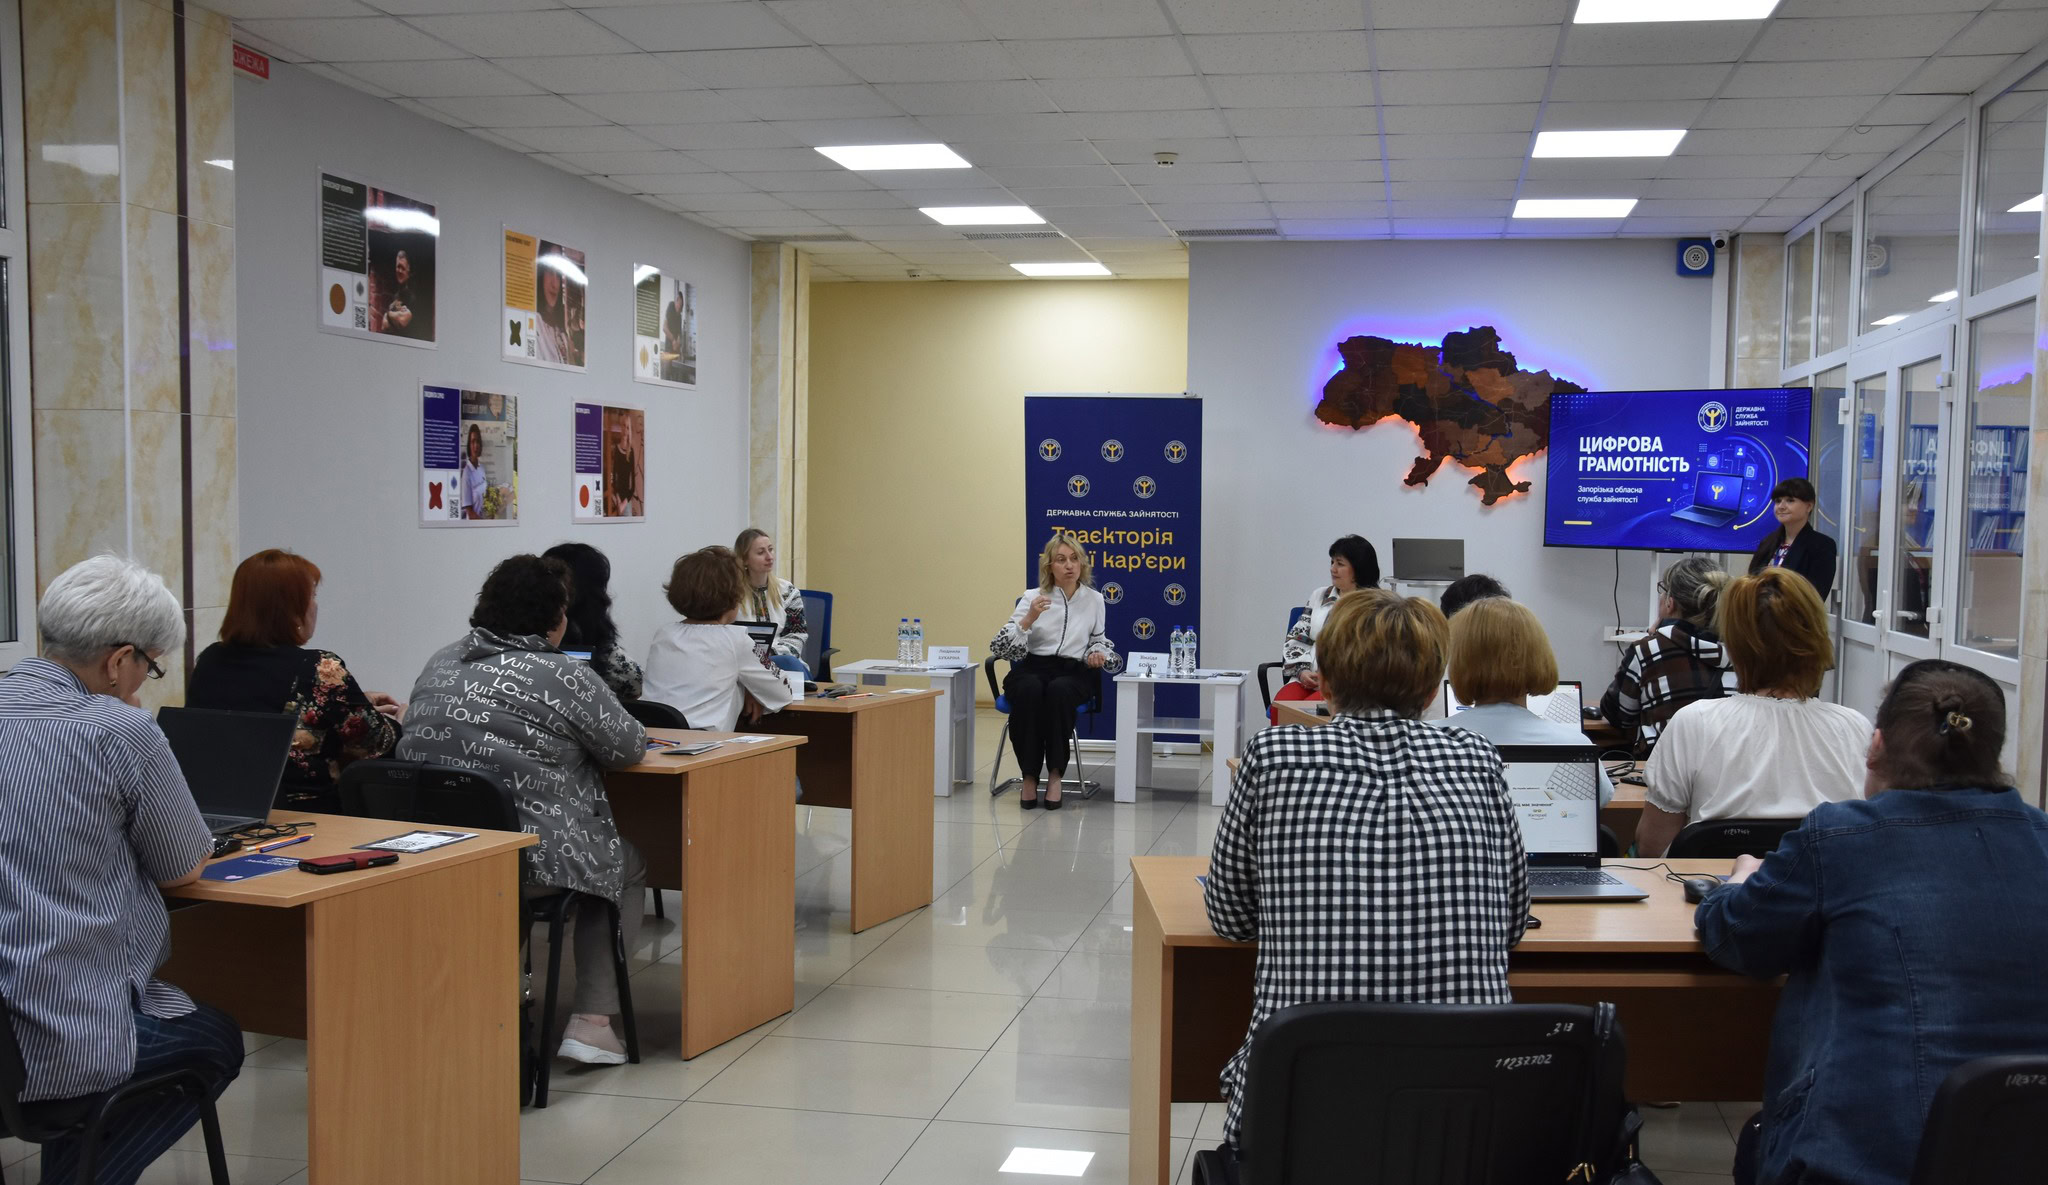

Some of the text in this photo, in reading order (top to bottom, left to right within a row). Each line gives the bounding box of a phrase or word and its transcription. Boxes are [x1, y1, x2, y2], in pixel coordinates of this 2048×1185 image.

[233, 49, 265, 74] ОЖЕЖА
[1579, 436, 1663, 454] ЦИФРОВА
[1578, 456, 1690, 472] ГРАМОТНІСТЬ
[1577, 485, 1643, 498] Запорізька обласна
[1577, 495, 1638, 504] служба зайнятості
[1046, 509, 1179, 519] ДЕРЖАВНА СЛУЖБА ЗАЙНЯТОСТІ
[501, 654, 533, 672] VUIT
[525, 652, 556, 669] PARIS
[423, 677, 457, 688] OUIS
[470, 662, 534, 686] TTON PARIS
[573, 669, 597, 694] PARIS
[464, 680, 497, 696] VUIT
[493, 676, 540, 703] LOUIS
[555, 667, 595, 703] LOUIS
[433, 693, 463, 705] TTON
[466, 692, 498, 707] PARIS
[414, 703, 440, 718] VUIT
[446, 704, 491, 724] LOUIS
[570, 699, 598, 729] TTON
[599, 704, 622, 733] VUIT
[415, 725, 452, 741] LOUIS
[484, 732, 515, 748] PARIS
[402, 748, 427, 761] VUIT
[462, 740, 495, 757] VUIT
[440, 755, 500, 773] TTON PARIS
[513, 771, 548, 792] VUIT
[539, 767, 565, 783] TTON
[522, 797, 562, 817] LOUIS
